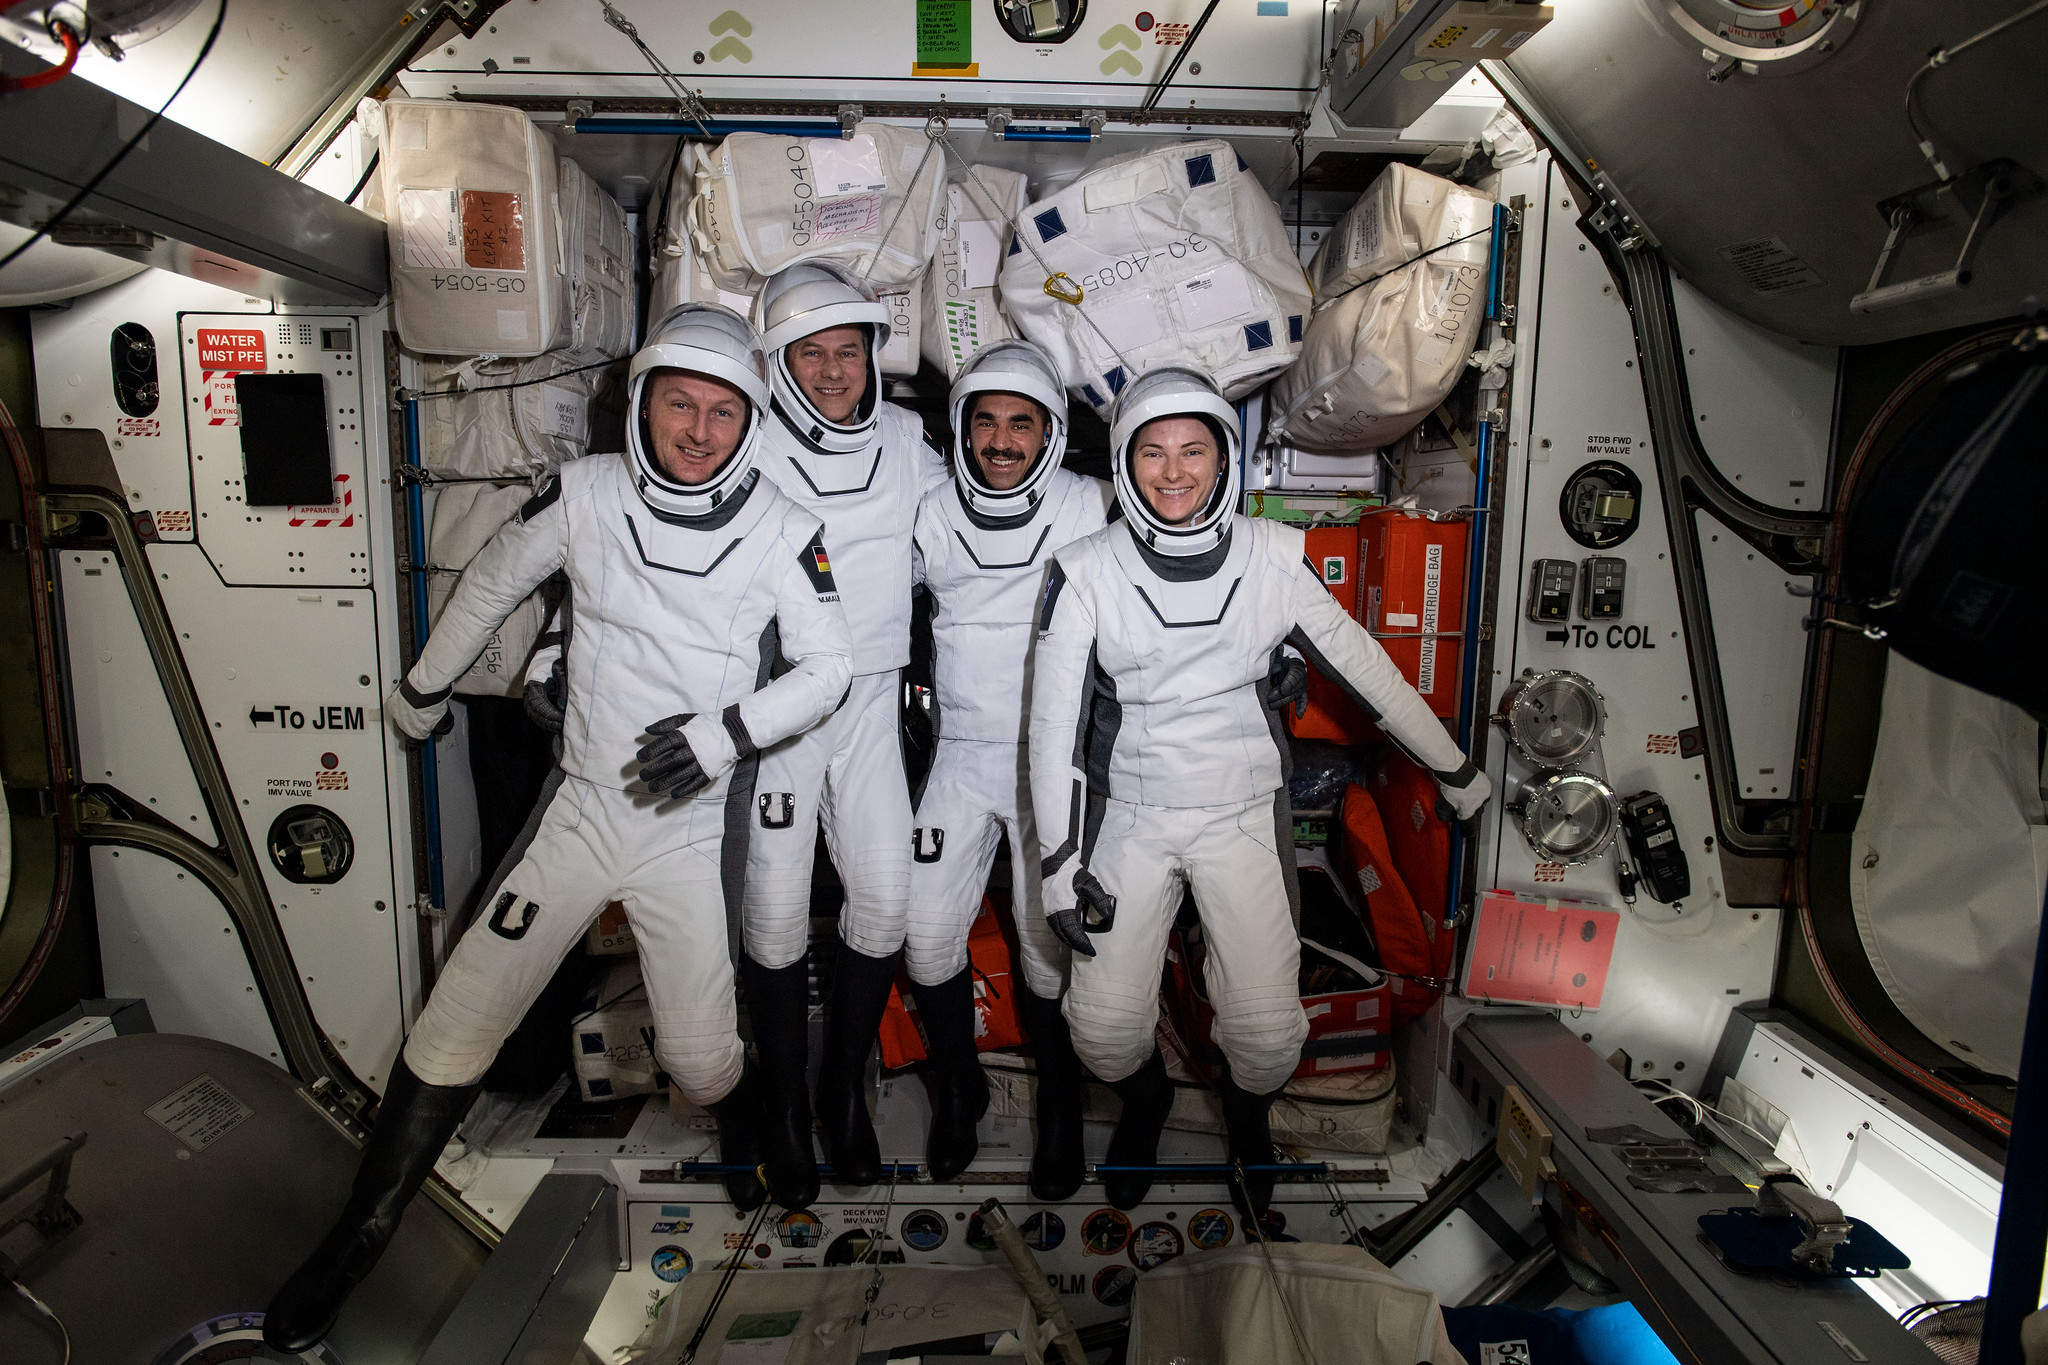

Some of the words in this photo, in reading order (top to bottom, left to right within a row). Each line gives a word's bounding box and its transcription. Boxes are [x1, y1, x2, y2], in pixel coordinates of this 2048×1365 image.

[1728, 26, 1785, 40] UNLATCHED
[481, 197, 493, 224] KIT
[469, 228, 479, 252] ISS
[498, 224, 508, 245] #2
[484, 231, 496, 265] LEAK
[1081, 233, 1206, 294] 3.0-4085
[1435, 266, 1480, 344] 1.0-1073
[894, 296, 911, 337] 1.0-5
[206, 334, 257, 347] WATER
[202, 350, 235, 362] MIST
[237, 351, 264, 363] PFE
[224, 395, 236, 403] FI
[1588, 436, 1611, 444] STDB
[1613, 437, 1632, 445] FWD
[1604, 447, 1631, 455] VALVE
[1428, 547, 1440, 570] BAG
[1423, 573, 1439, 635] CARTRIDGE
[1572, 625, 1599, 649] To
[1606, 625, 1656, 649] COL
[1420, 639, 1434, 691] AMMONIA
[274, 705, 305, 730] To
[312, 706, 365, 730] JEM
[267, 779, 291, 787] PORT
[293, 780, 312, 788] FWD
[285, 789, 312, 797] VALVE
[219, 1113, 243, 1131] CLOSING
[200, 1128, 220, 1145] HATCH
[843, 1209, 865, 1217] DECK
[867, 1209, 886, 1217] FWD
[844, 1217, 858, 1225] IMV
